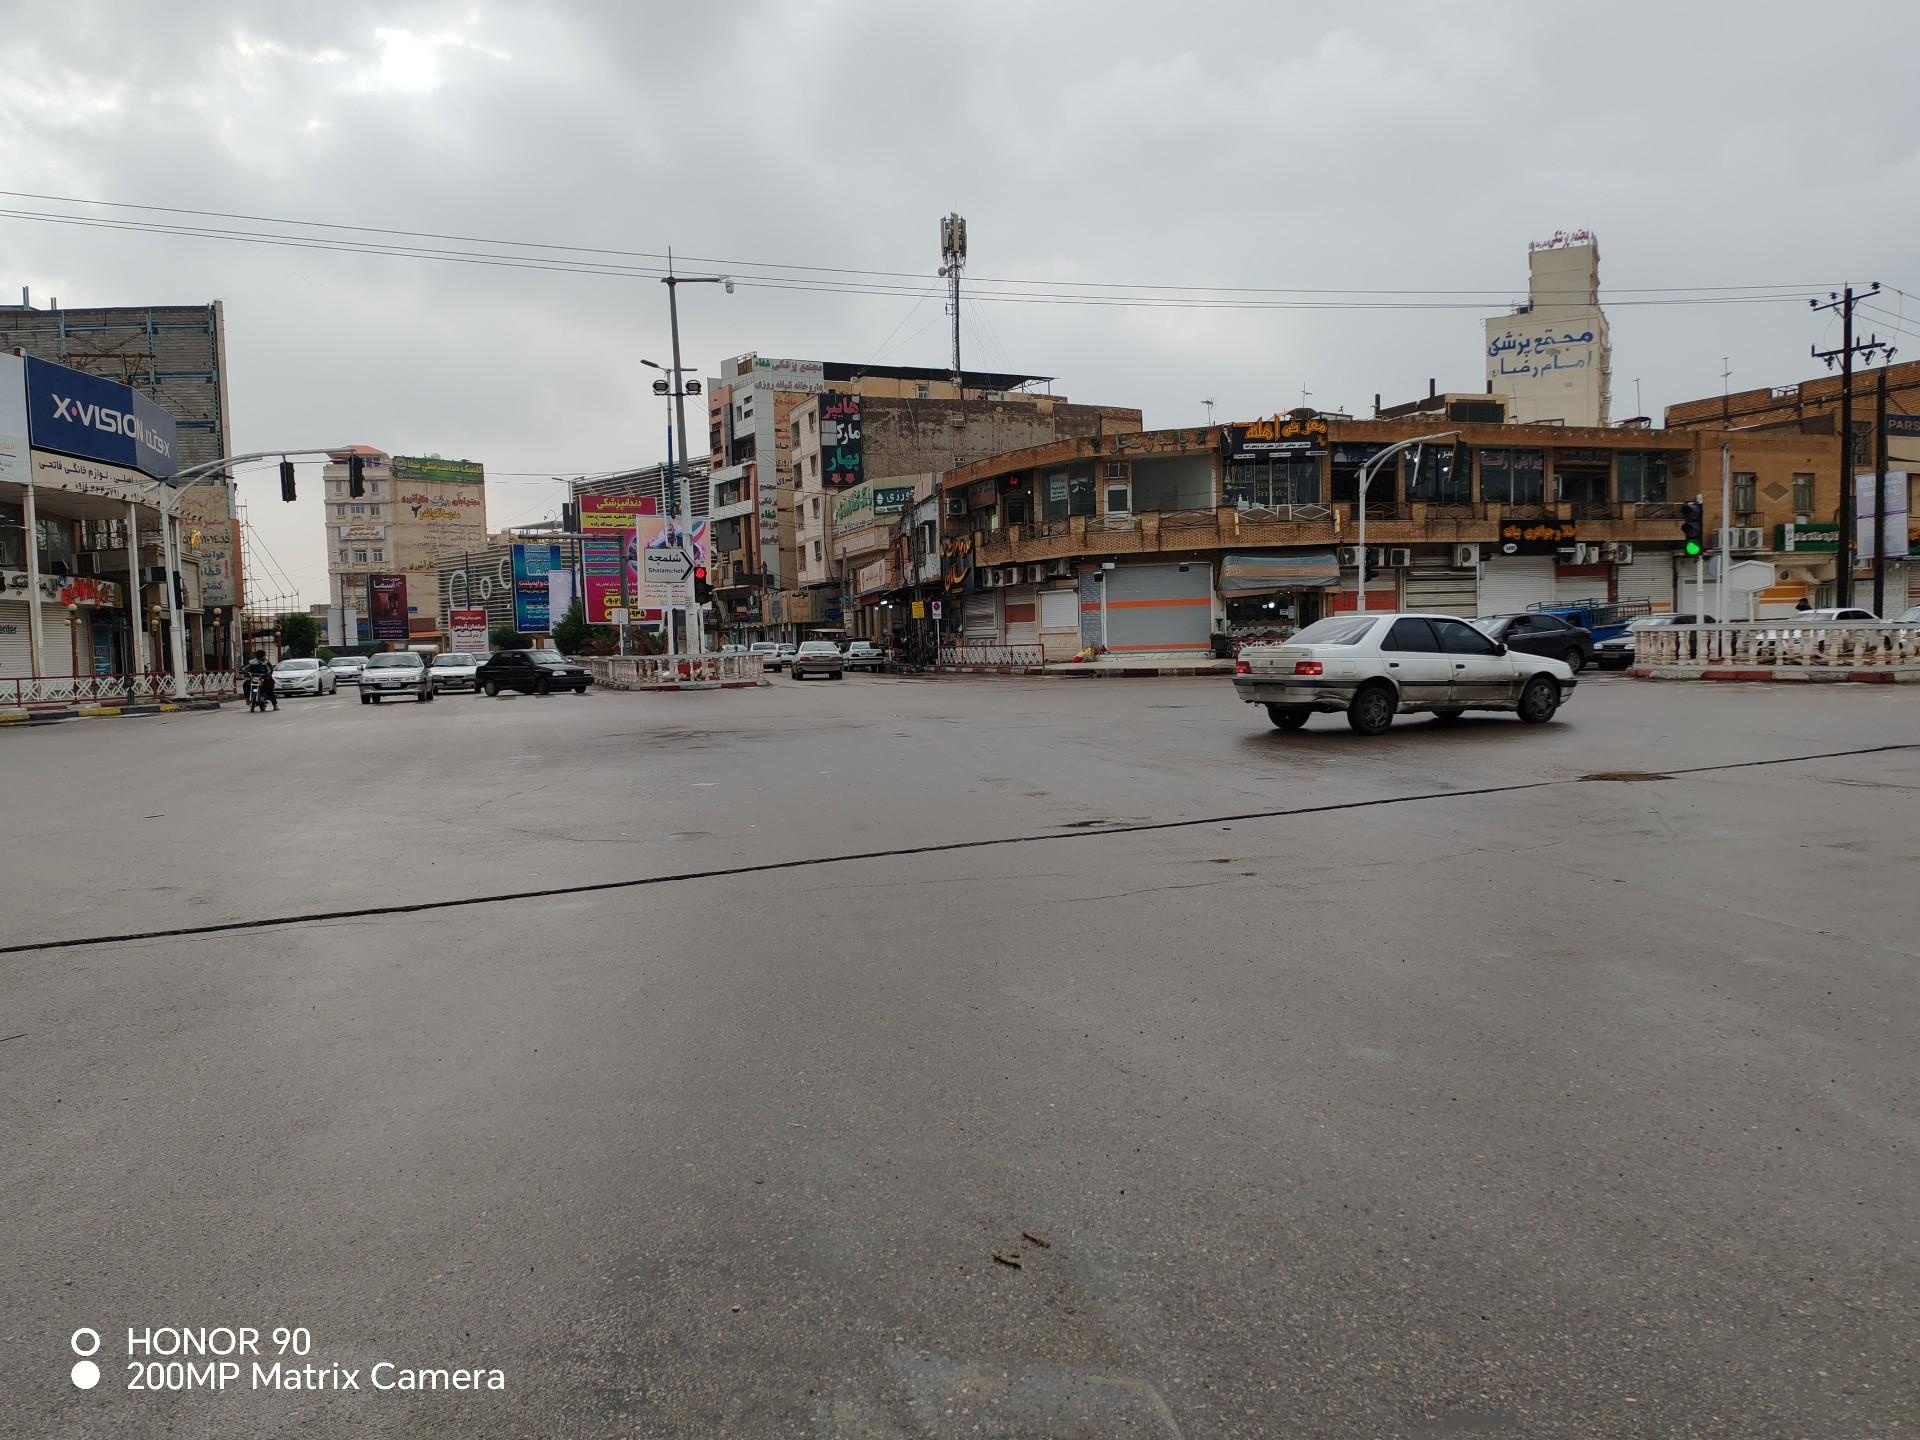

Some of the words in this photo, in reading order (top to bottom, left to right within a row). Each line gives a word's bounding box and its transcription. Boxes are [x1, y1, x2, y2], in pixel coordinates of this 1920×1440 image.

[1488, 331, 1531, 358] پزشکی
[1534, 329, 1593, 355] مجتمع
[1501, 357, 1538, 378] رضا
[1541, 350, 1593, 377] امام
[820, 396, 859, 420] هایپر
[39, 460, 63, 471] فاتحی
[64, 462, 87, 475] خانگی
[825, 447, 860, 472] بهار
[88, 469, 109, 481] لوازم
[596, 497, 642, 511] دندانپزشکی
[648, 553, 682, 566] شلمچه
